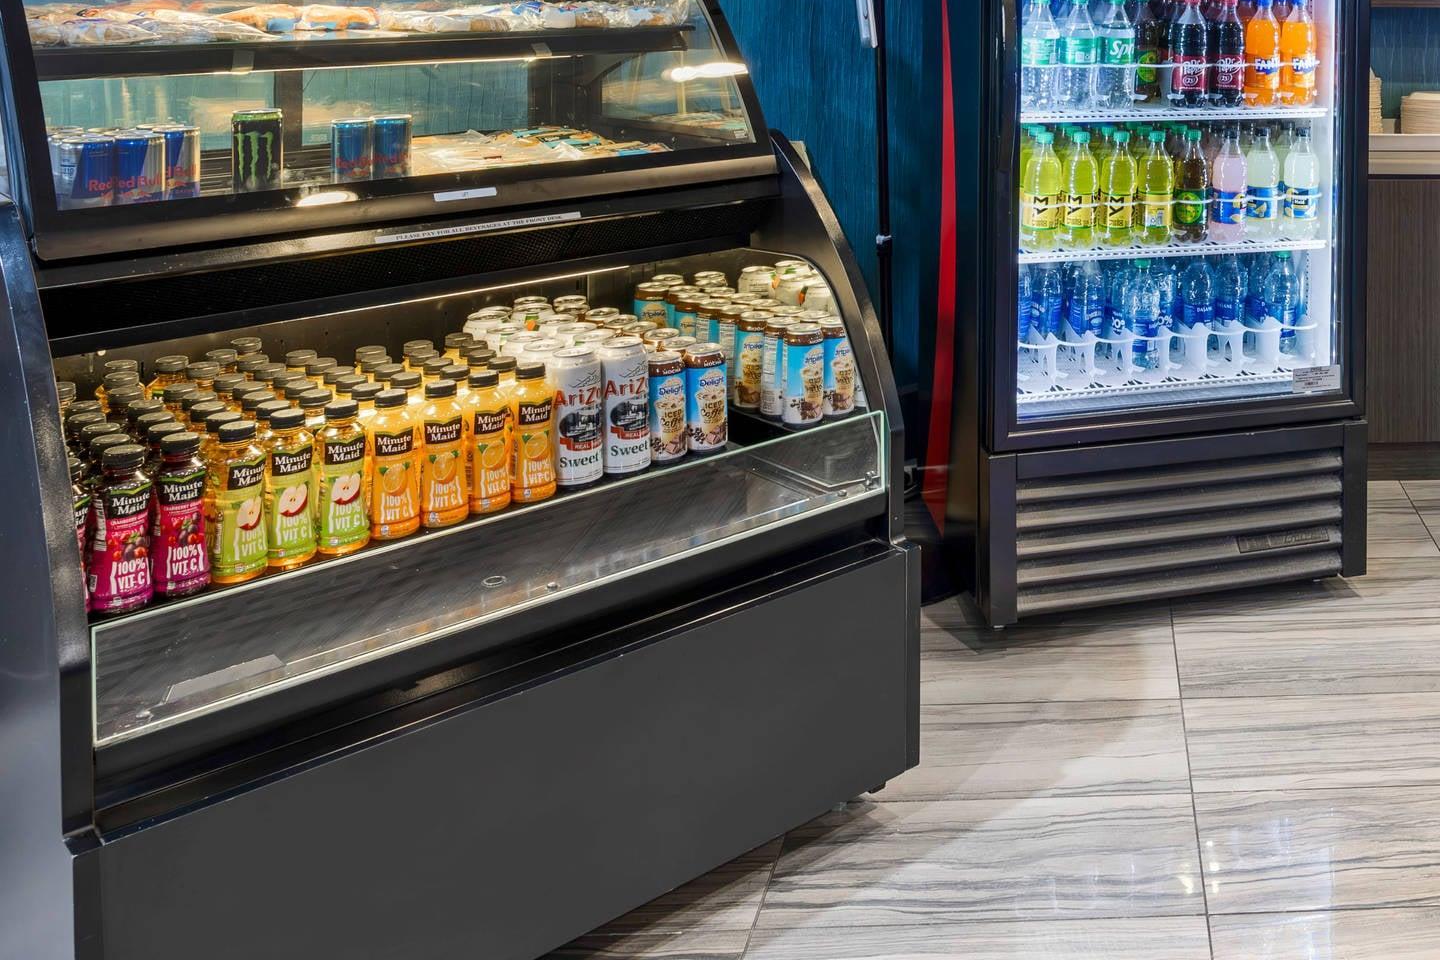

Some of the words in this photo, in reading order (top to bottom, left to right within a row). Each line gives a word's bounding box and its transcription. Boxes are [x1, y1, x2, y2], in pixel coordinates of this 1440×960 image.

[395, 232, 421, 241] PLEASE
[422, 230, 436, 239] PAY
[464, 222, 502, 233] BEVERAGES
[700, 376, 724, 387] Delight
[525, 412, 548, 422] Maid
[426, 423, 461, 434] Minute
[377, 434, 412, 446] Minute
[431, 431, 457, 441] Maid
[328, 440, 364, 455] Minute
[382, 443, 407, 453] Maid
[610, 440, 648, 457] Sweet
[275, 452, 311, 467] Minute
[333, 451, 360, 462] Maid
[560, 452, 599, 468] Sweet
[280, 461, 307, 473] Maid
[164, 480, 203, 494] Minute
[112, 492, 150, 507] Minute
[169, 489, 199, 502] Maid
[117, 501, 147, 515] Maid
[335, 516, 352, 531] VIT
[172, 544, 198, 561] 100%
[118, 558, 146, 575] 100%
[172, 560, 189, 576] VIT
[118, 575, 137, 591] VIT
